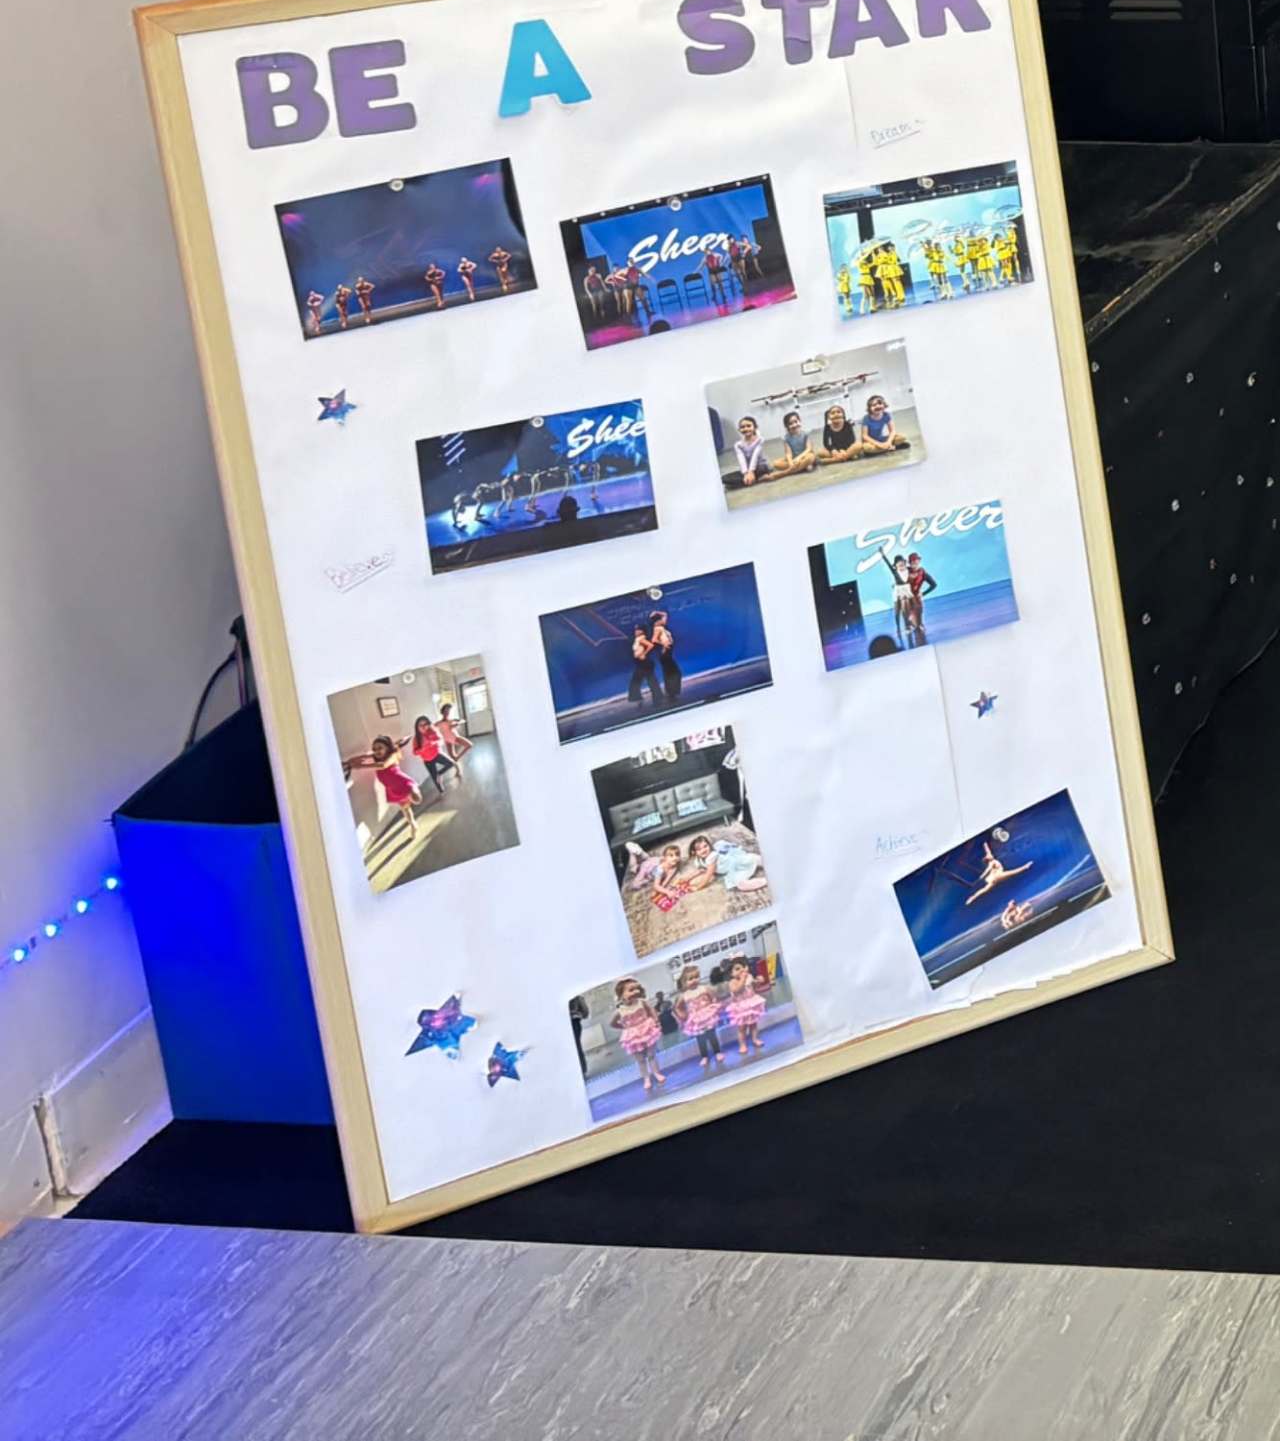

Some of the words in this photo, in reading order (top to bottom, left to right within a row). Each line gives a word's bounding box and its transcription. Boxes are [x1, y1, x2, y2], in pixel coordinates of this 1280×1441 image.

[235, 39, 416, 150] BE
[497, 19, 592, 119] A
[627, 228, 730, 273] Sheer
[855, 504, 1004, 573] Sheer
